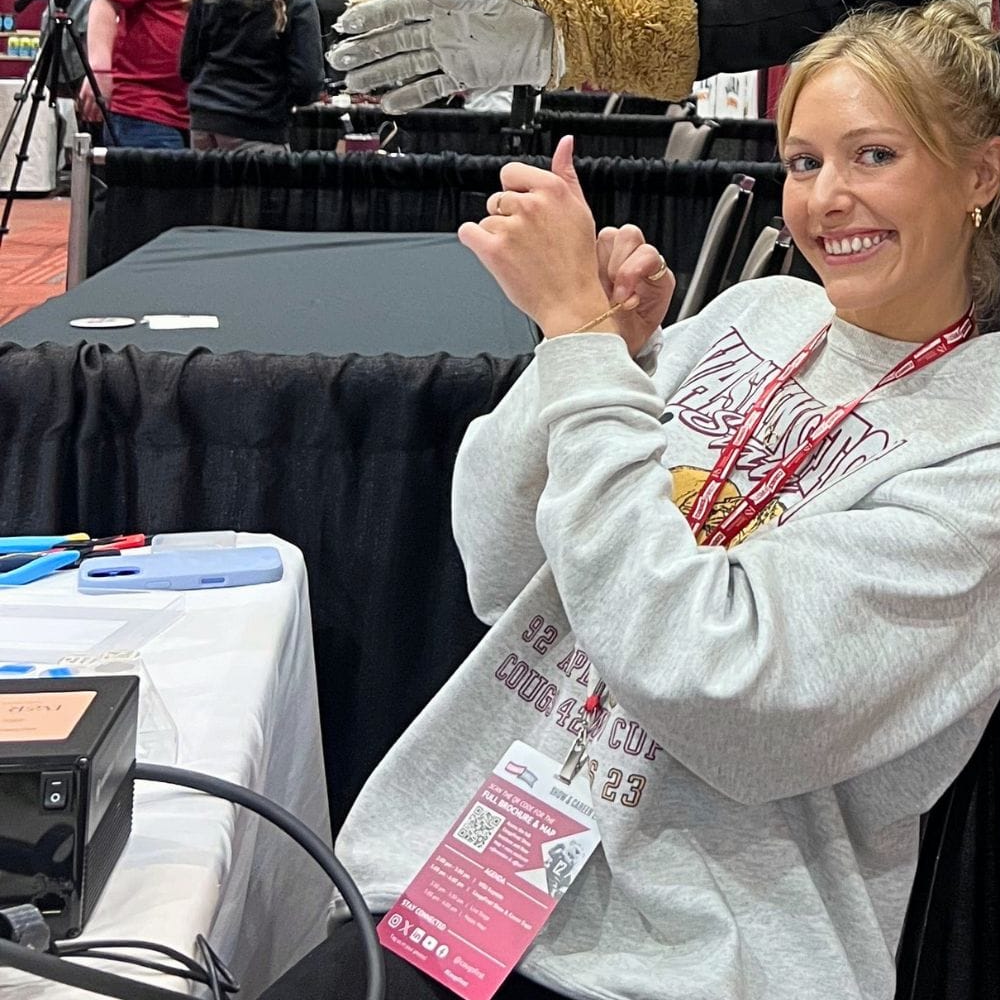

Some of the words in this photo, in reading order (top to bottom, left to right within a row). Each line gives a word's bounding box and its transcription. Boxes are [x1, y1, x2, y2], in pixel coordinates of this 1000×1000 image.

[522, 615, 558, 656] 92
[601, 767, 647, 808] 23
[482, 790, 498, 804] FULL
[498, 799, 532, 823] BROCHURE
[532, 819, 539, 827] &
[539, 823, 556, 836] MAP
[502, 791, 512, 799] THE
[519, 801, 533, 811] CODE
[532, 808, 544, 817] FOR
[544, 815, 555, 824] THE
[483, 867, 505, 884] AGENDA
[401, 899, 416, 910] STAY
[414, 907, 446, 931] CONNECTED
